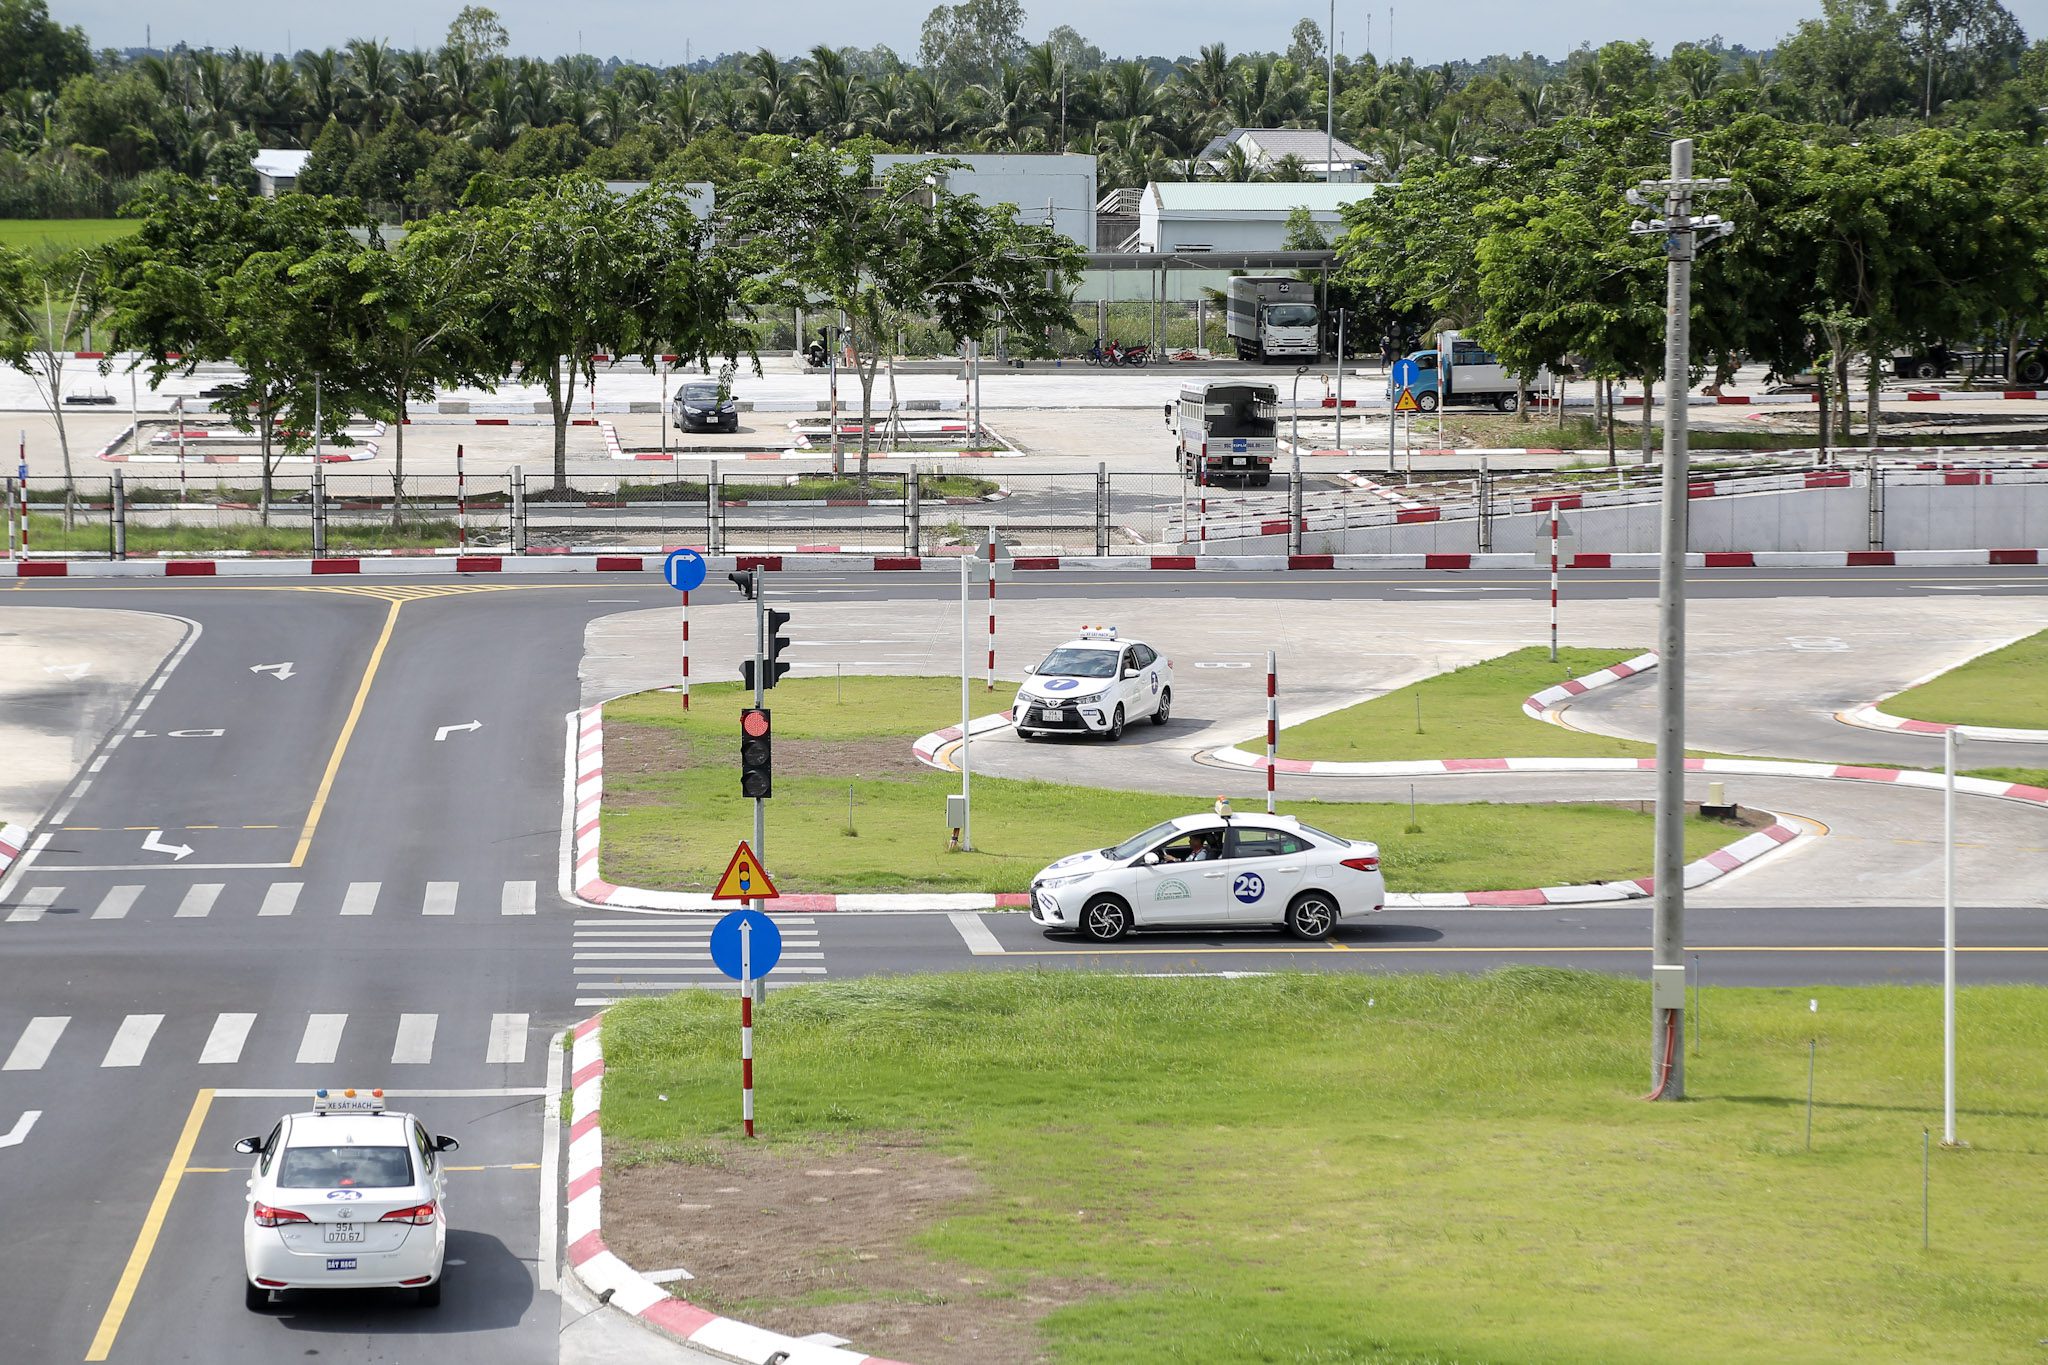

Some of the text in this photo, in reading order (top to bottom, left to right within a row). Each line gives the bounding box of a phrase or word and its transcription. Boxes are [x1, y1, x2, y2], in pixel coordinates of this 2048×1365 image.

[1280, 284, 1289, 292] 22
[1052, 679, 1070, 688] 7
[1235, 876, 1262, 897] 29
[338, 1100, 350, 1109] SÁT
[336, 1222, 353, 1231] 95A
[327, 1258, 340, 1269] SÁT
